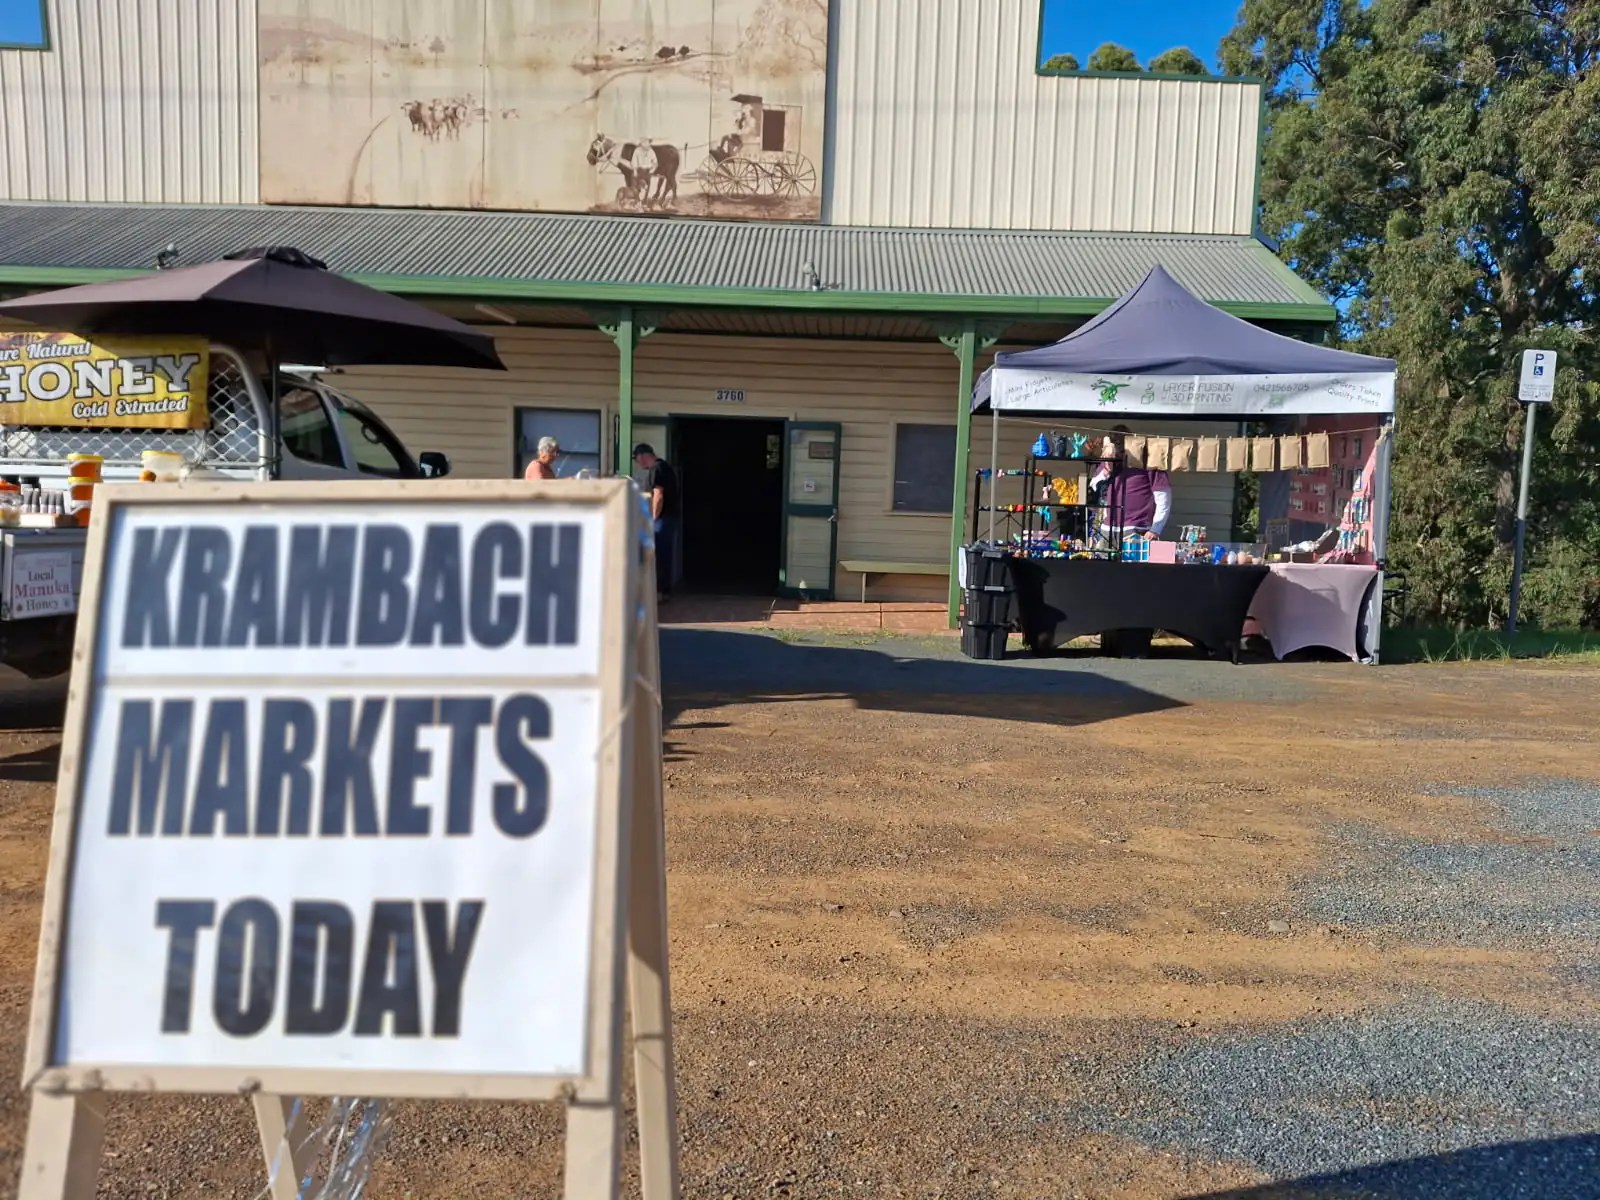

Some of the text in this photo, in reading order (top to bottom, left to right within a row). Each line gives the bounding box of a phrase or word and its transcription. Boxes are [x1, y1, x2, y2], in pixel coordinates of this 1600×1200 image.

[27, 342, 91, 359] Natural
[1535, 353, 1544, 364] P
[0, 353, 199, 402] HONEY
[716, 390, 744, 401] 3760
[1163, 383, 1234, 392] LAYER FUSION
[1170, 392, 1232, 402] 3D PRINTING
[73, 397, 189, 419] Cold Extracted
[28, 567, 54, 582] Local
[14, 579, 71, 598] Manuka
[120, 521, 583, 650] KRAMBACH
[26, 599, 59, 611] Honey
[106, 692, 554, 840] MARKETS
[154, 896, 487, 1039] TODAY
